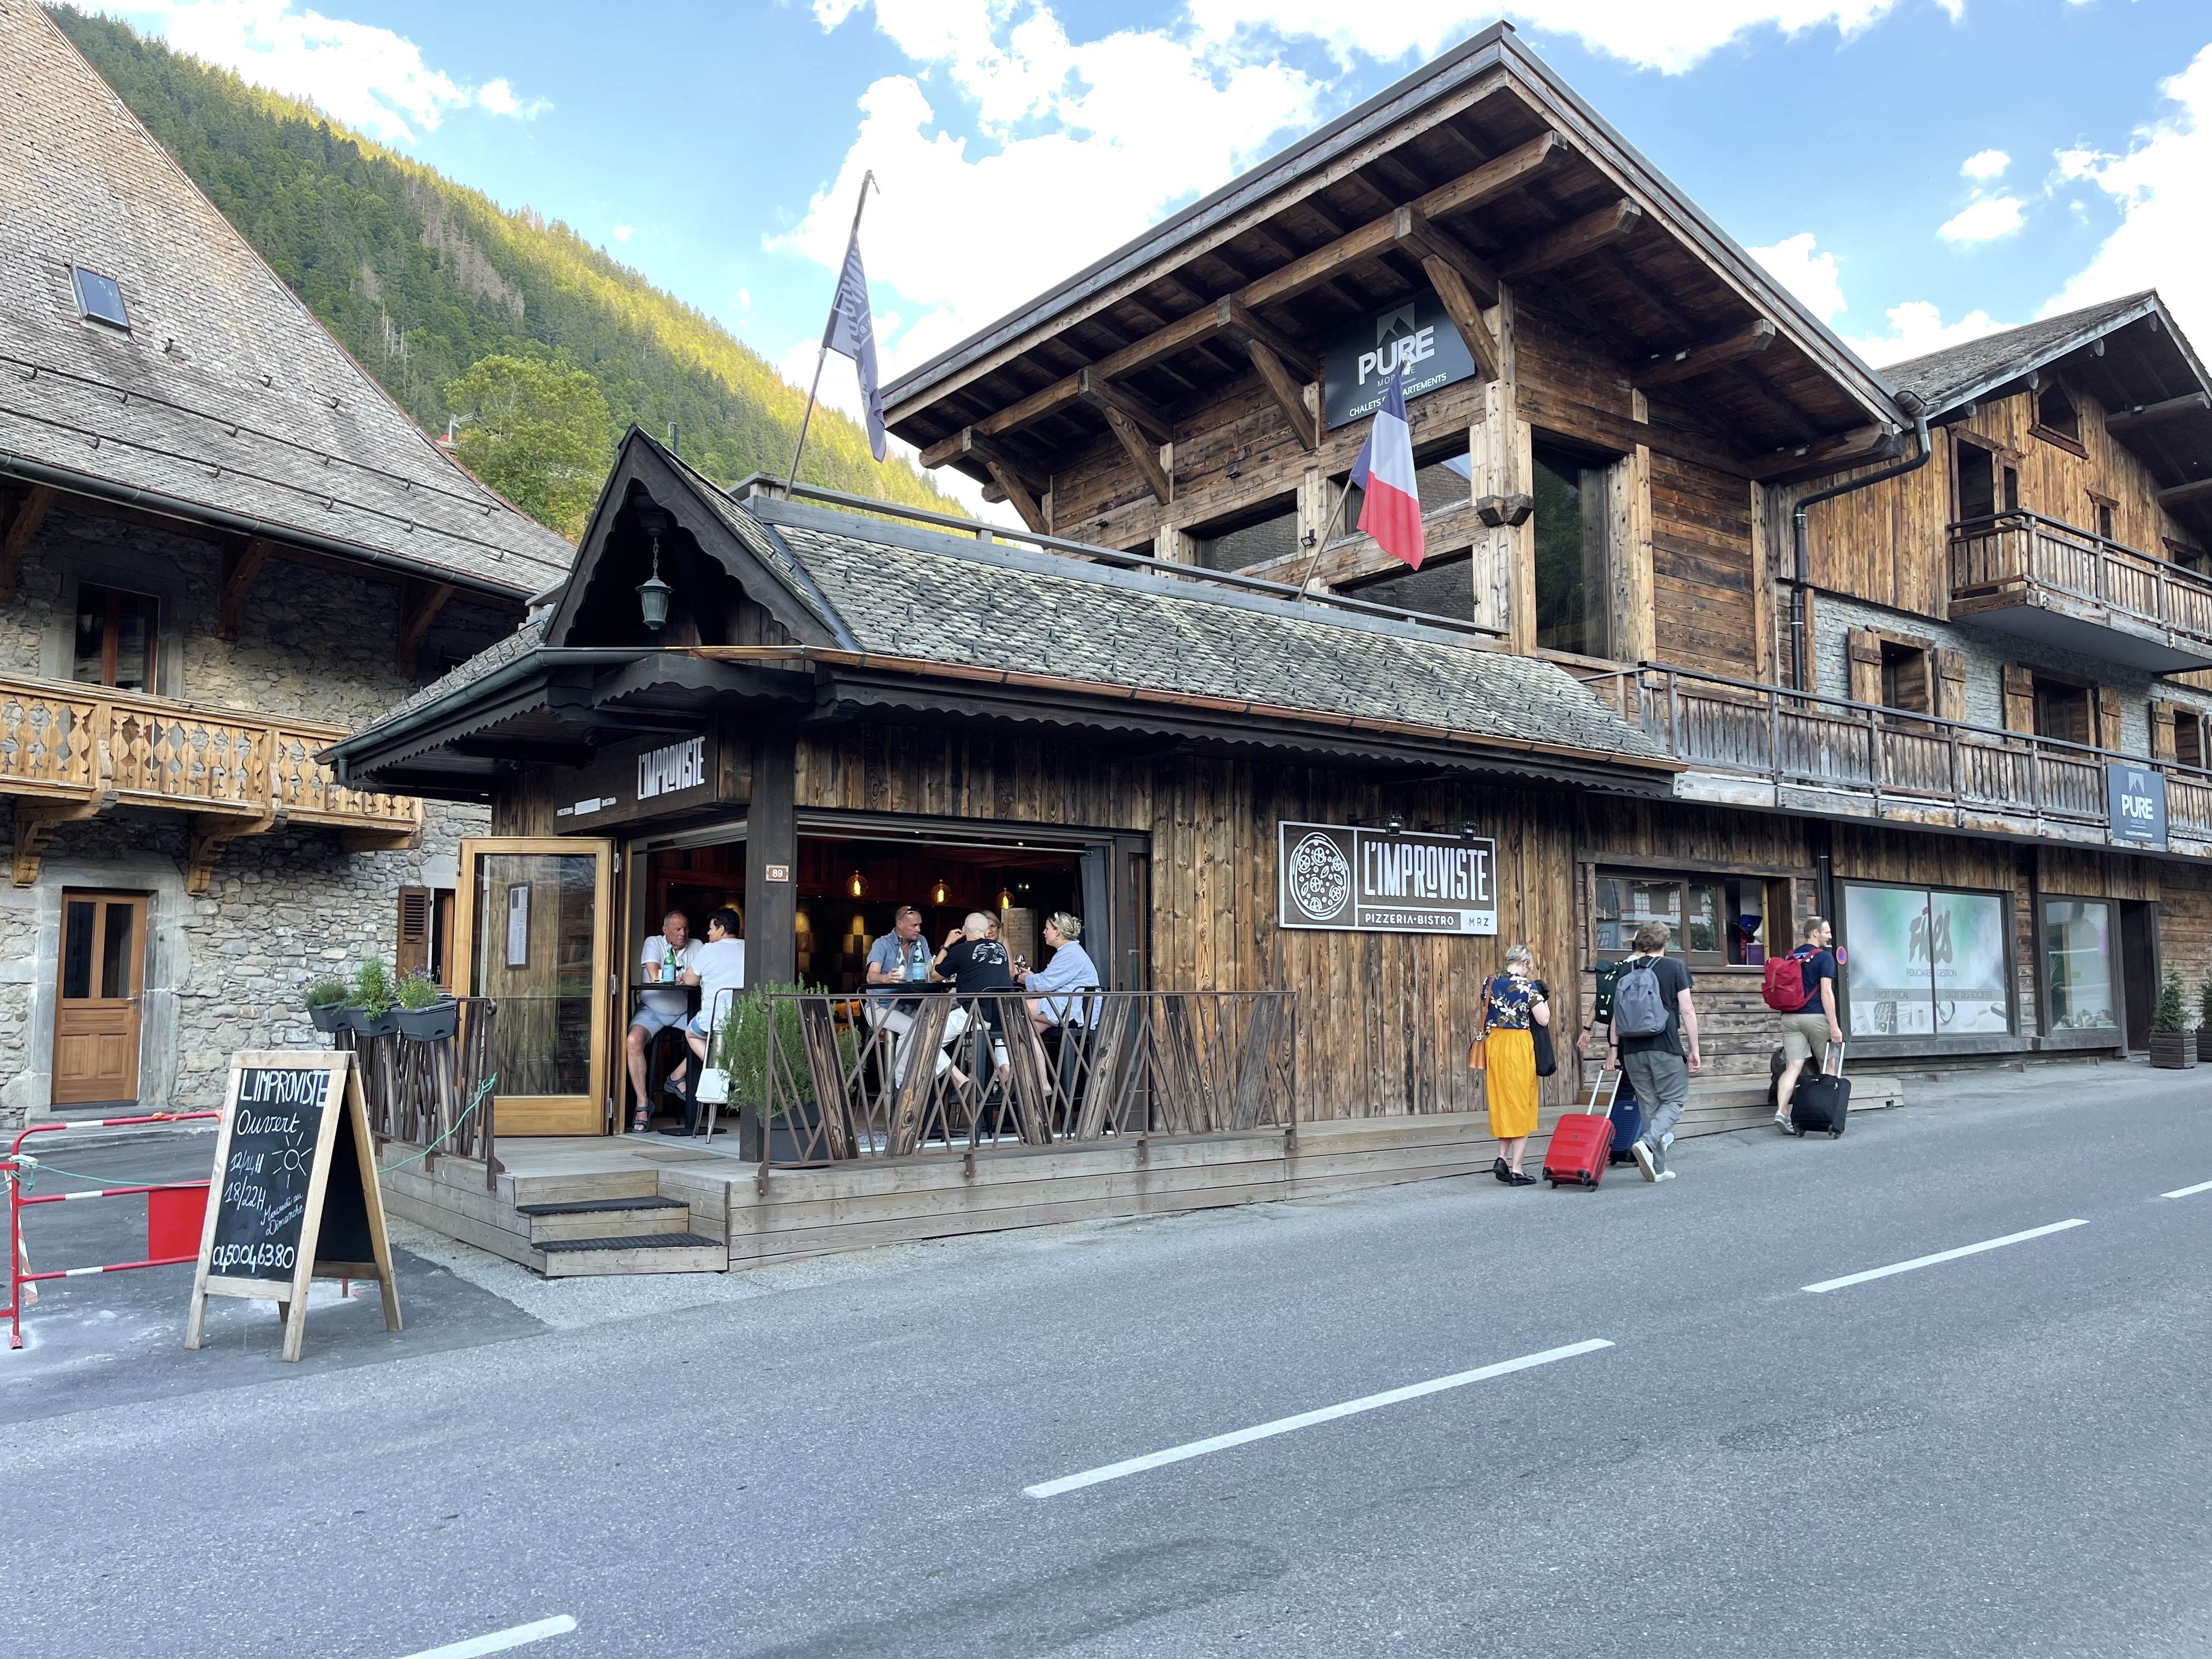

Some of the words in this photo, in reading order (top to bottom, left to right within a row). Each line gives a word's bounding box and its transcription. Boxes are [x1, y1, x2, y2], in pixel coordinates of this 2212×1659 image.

[1358, 325, 1435, 385] PURE
[1349, 398, 1381, 417] CHALETS
[1402, 372, 1447, 396] ARTEMENTS
[637, 736, 706, 800] L'IMPROVISTE
[2121, 794, 2153, 820] PURE
[772, 869, 783, 878] 89
[1364, 840, 1489, 901] L'IMPROVISTE
[1937, 969, 1957, 977] GESTION
[1874, 990, 1890, 999] DROIT
[1891, 990, 1909, 999] FISCAL
[1945, 990, 1959, 999] DROIT
[1961, 990, 1970, 999] DES
[237, 1109, 300, 1135] Ouvert
[224, 1175, 266, 1211] 18/22H
[293, 1192, 303, 1204] au
[266, 1204, 304, 1236] Dimanche
